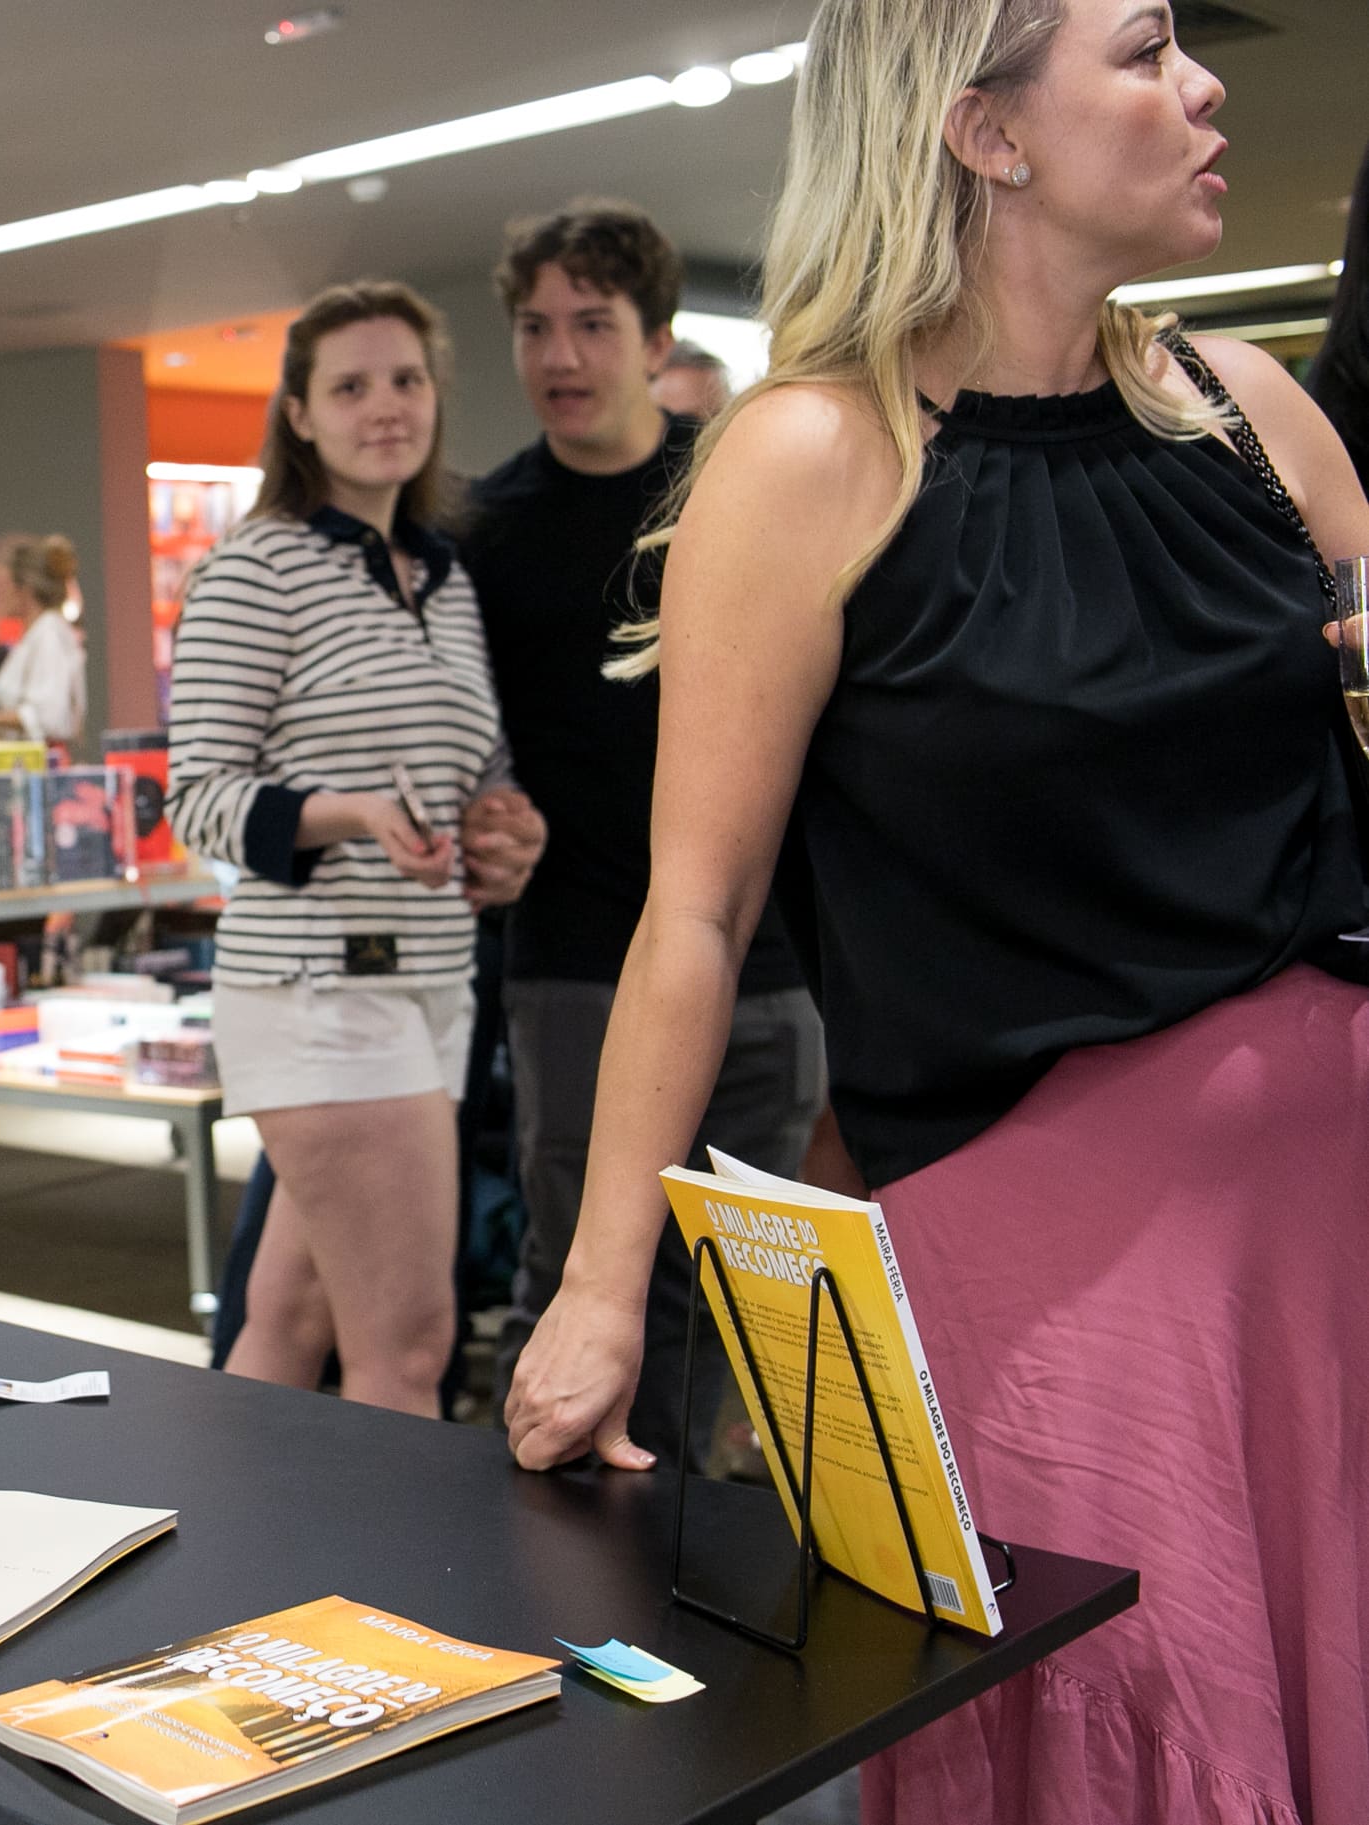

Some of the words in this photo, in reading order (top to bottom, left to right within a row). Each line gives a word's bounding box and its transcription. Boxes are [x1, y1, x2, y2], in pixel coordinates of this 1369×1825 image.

[705, 1200, 719, 1226] O
[716, 1203, 802, 1251] MILAGRE
[796, 1218, 819, 1247] DO
[874, 1222, 892, 1266] MAIRA
[887, 1264, 903, 1303] FÉRIA
[919, 1370, 928, 1381] O
[922, 1383, 946, 1441] MILAGRE
[939, 1440, 951, 1460] DO
[945, 1460, 972, 1532] RECOMEÇO
[229, 1632, 270, 1648] O
[357, 1615, 429, 1646] MAIRA
[429, 1640, 496, 1662] FÉRIA
[164, 1645, 386, 1728] RECOMEÇO
[240, 1637, 410, 1697] MILAGRE
[391, 1681, 442, 1704] DO
